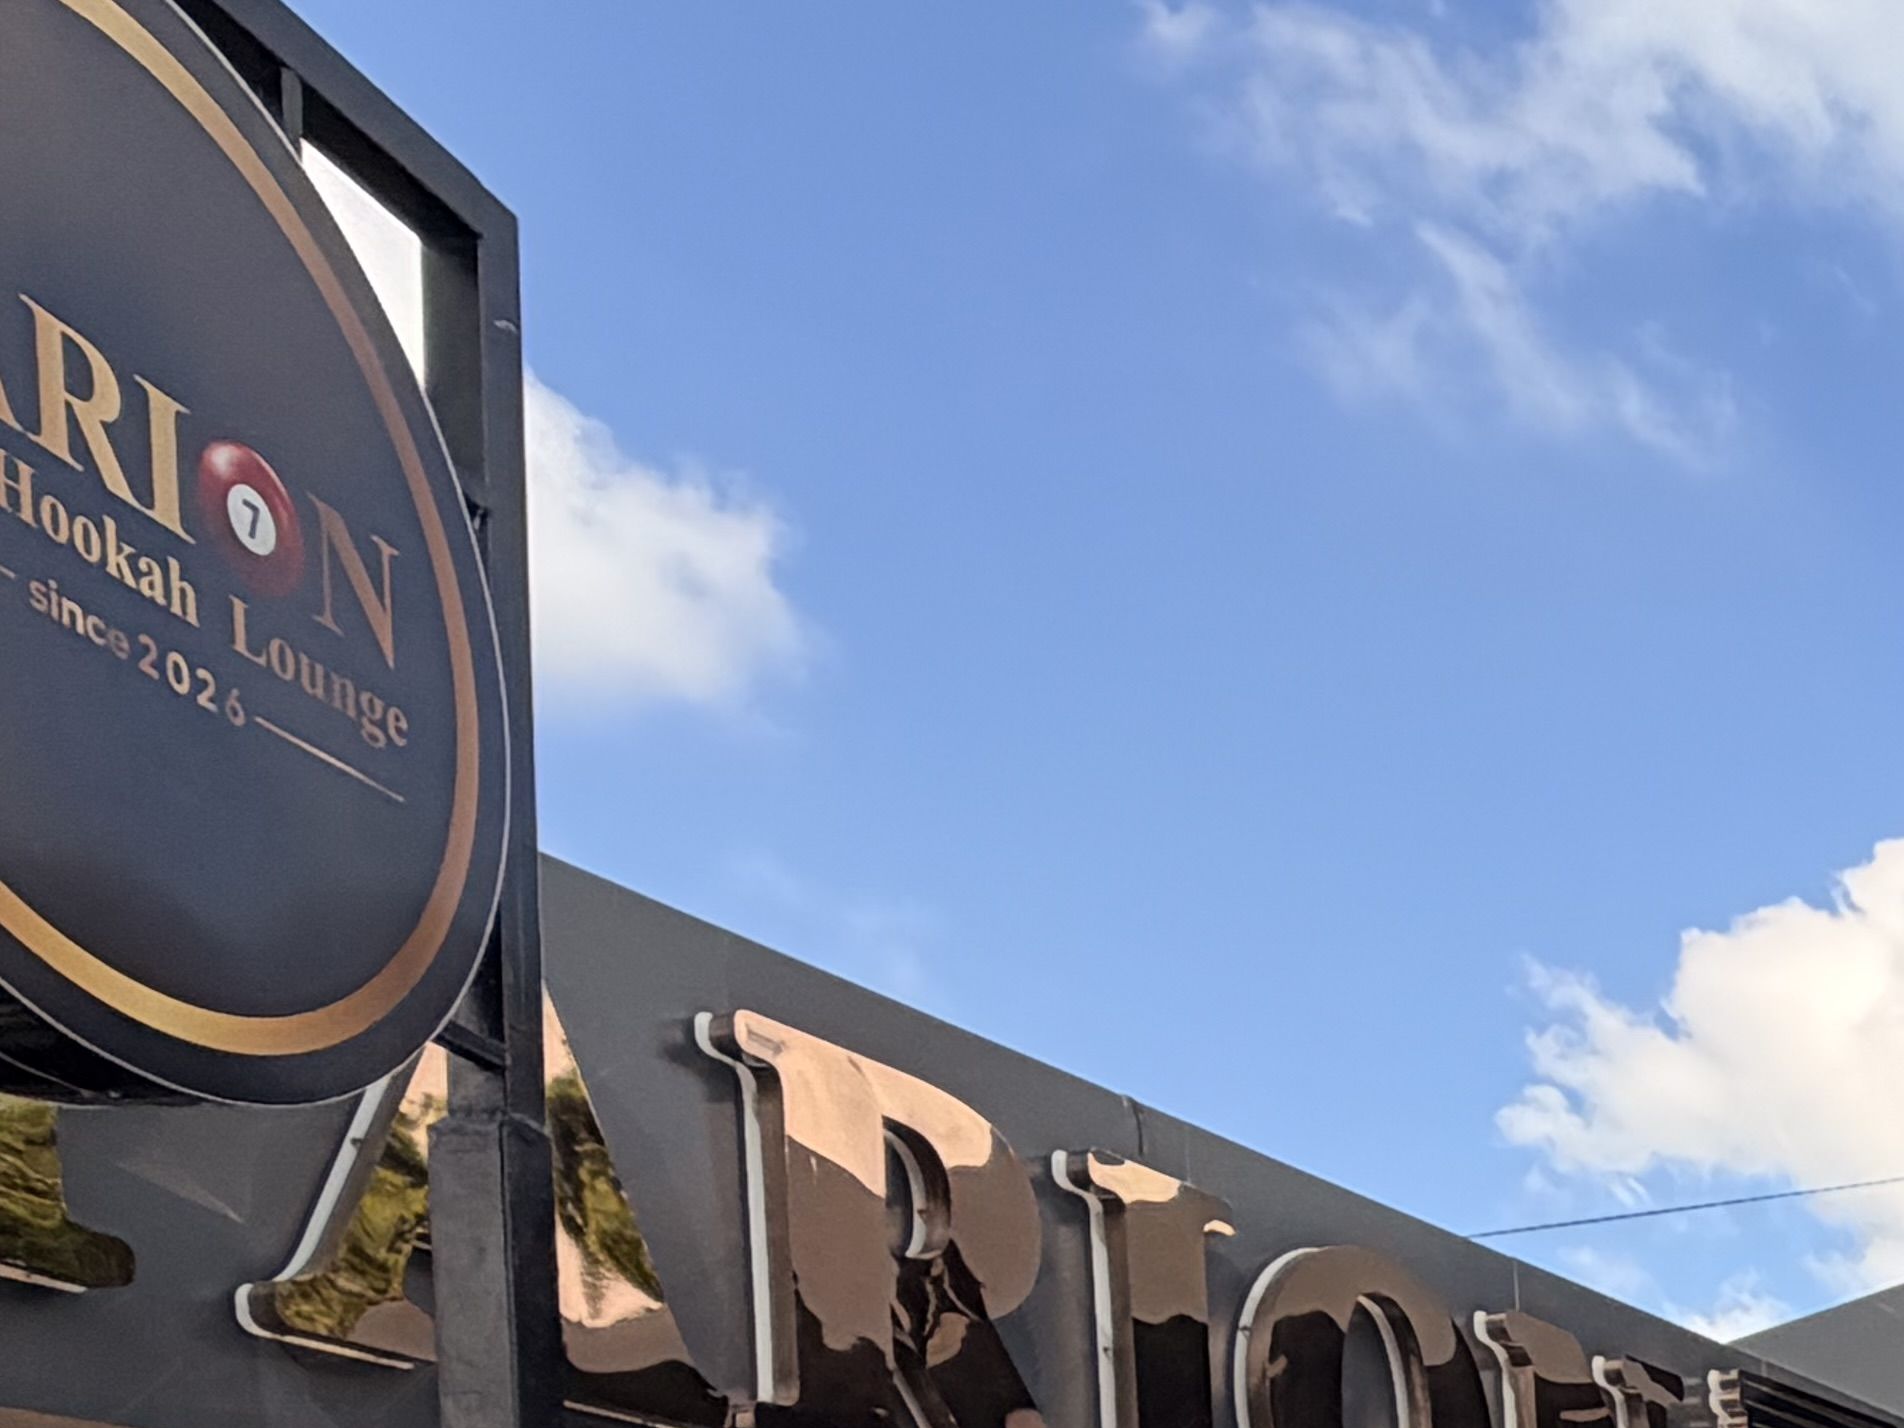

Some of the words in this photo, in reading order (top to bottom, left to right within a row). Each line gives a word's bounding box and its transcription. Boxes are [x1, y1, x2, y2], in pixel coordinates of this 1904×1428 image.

[242, 498, 261, 541] 7
[0, 447, 200, 628] Hookah
[229, 593, 409, 749] Lounge
[28, 578, 131, 661] since
[138, 633, 247, 728] 2026
